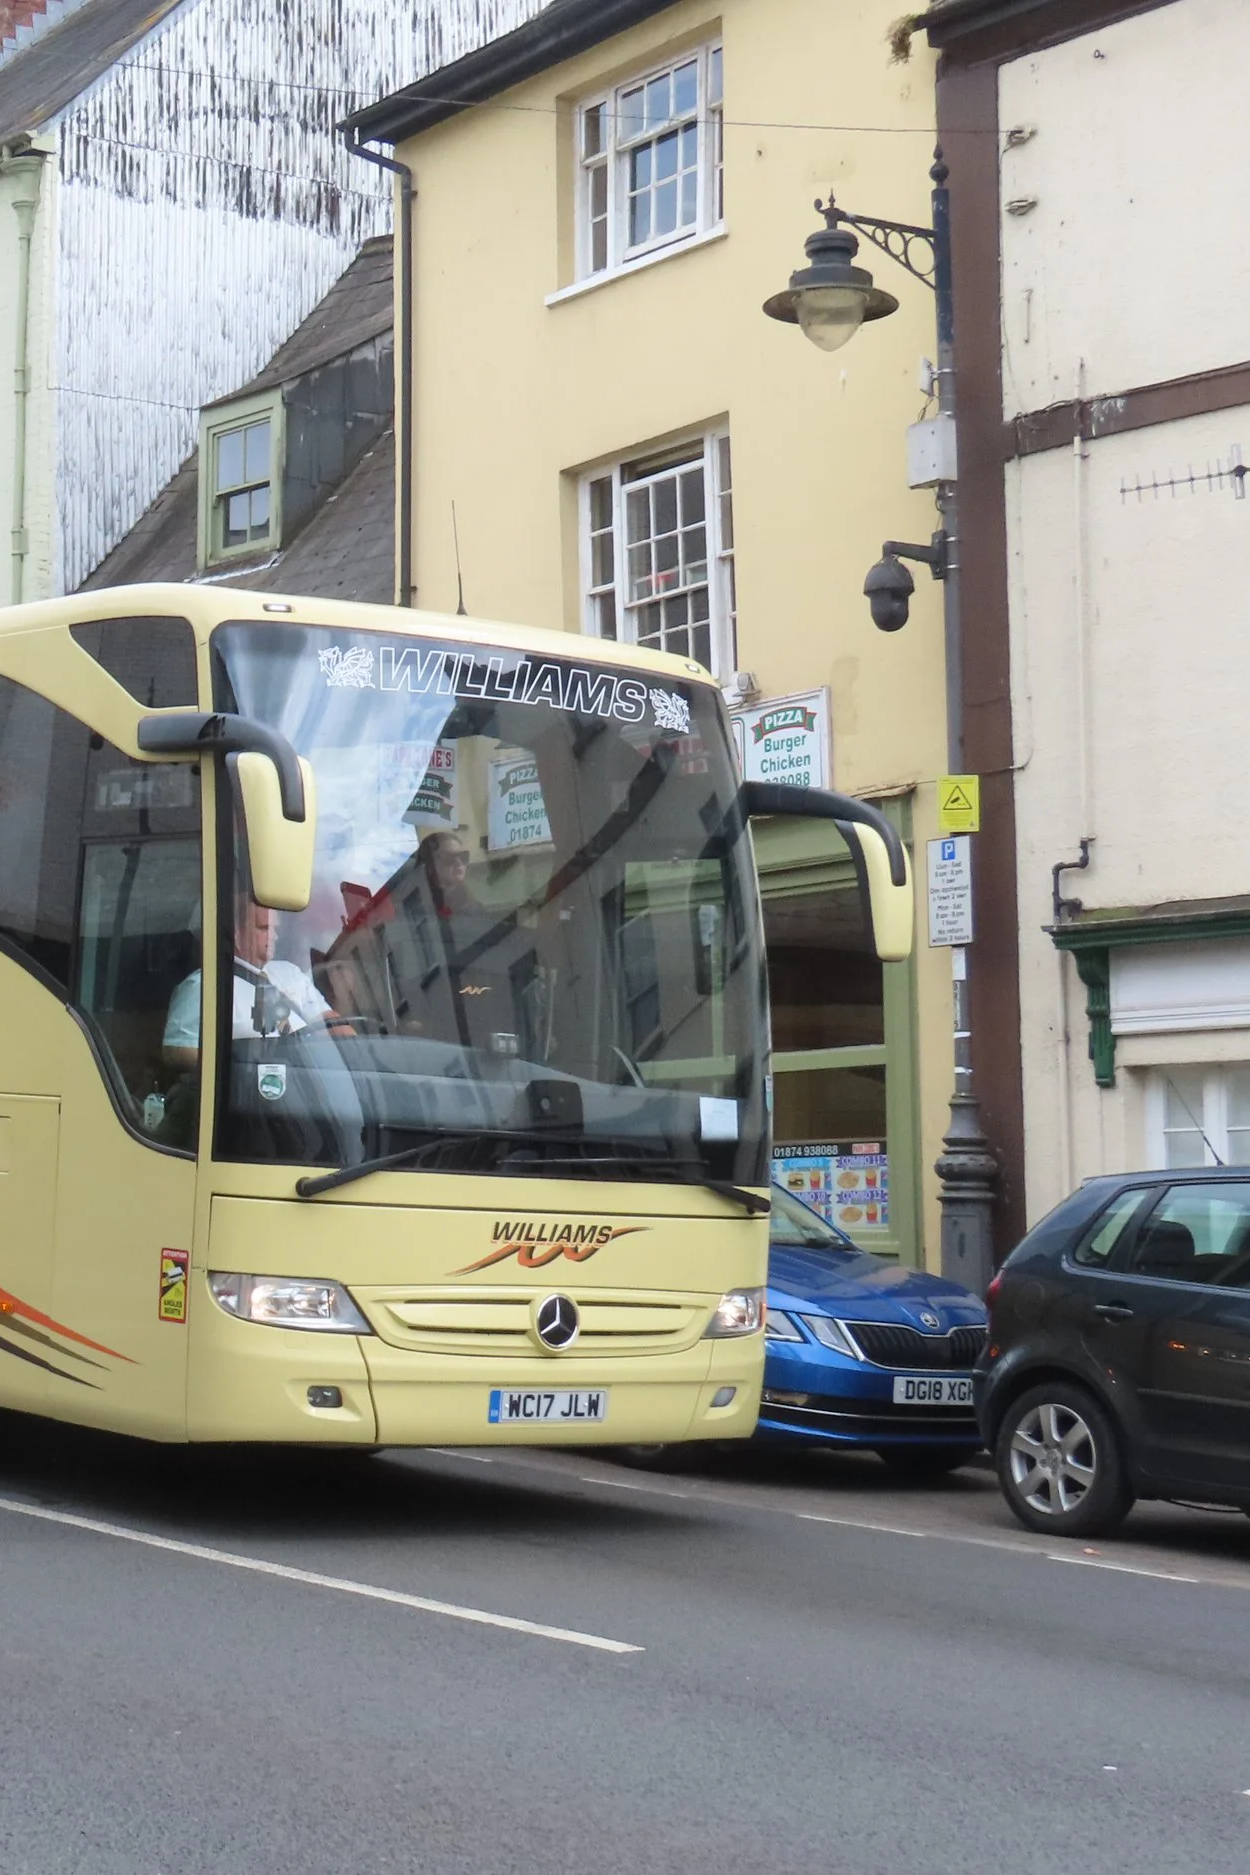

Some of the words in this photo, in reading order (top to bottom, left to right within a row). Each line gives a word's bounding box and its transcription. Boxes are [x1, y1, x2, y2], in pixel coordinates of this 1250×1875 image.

[379, 647, 650, 722] WILLIAMS
[764, 709, 803, 729] PIZZA
[764, 734, 807, 753] Burger
[760, 754, 811, 774] Chicken
[764, 771, 810, 786] 8088
[510, 825, 542, 843] 01874
[944, 843, 954, 859] P
[774, 1147, 802, 1157] 01874
[803, 1145, 839, 1156] 938088
[491, 1221, 613, 1245] WILLIAMS
[905, 1380, 943, 1400] DG18
[508, 1393, 555, 1417] WC17
[561, 1393, 600, 1417] JLW
